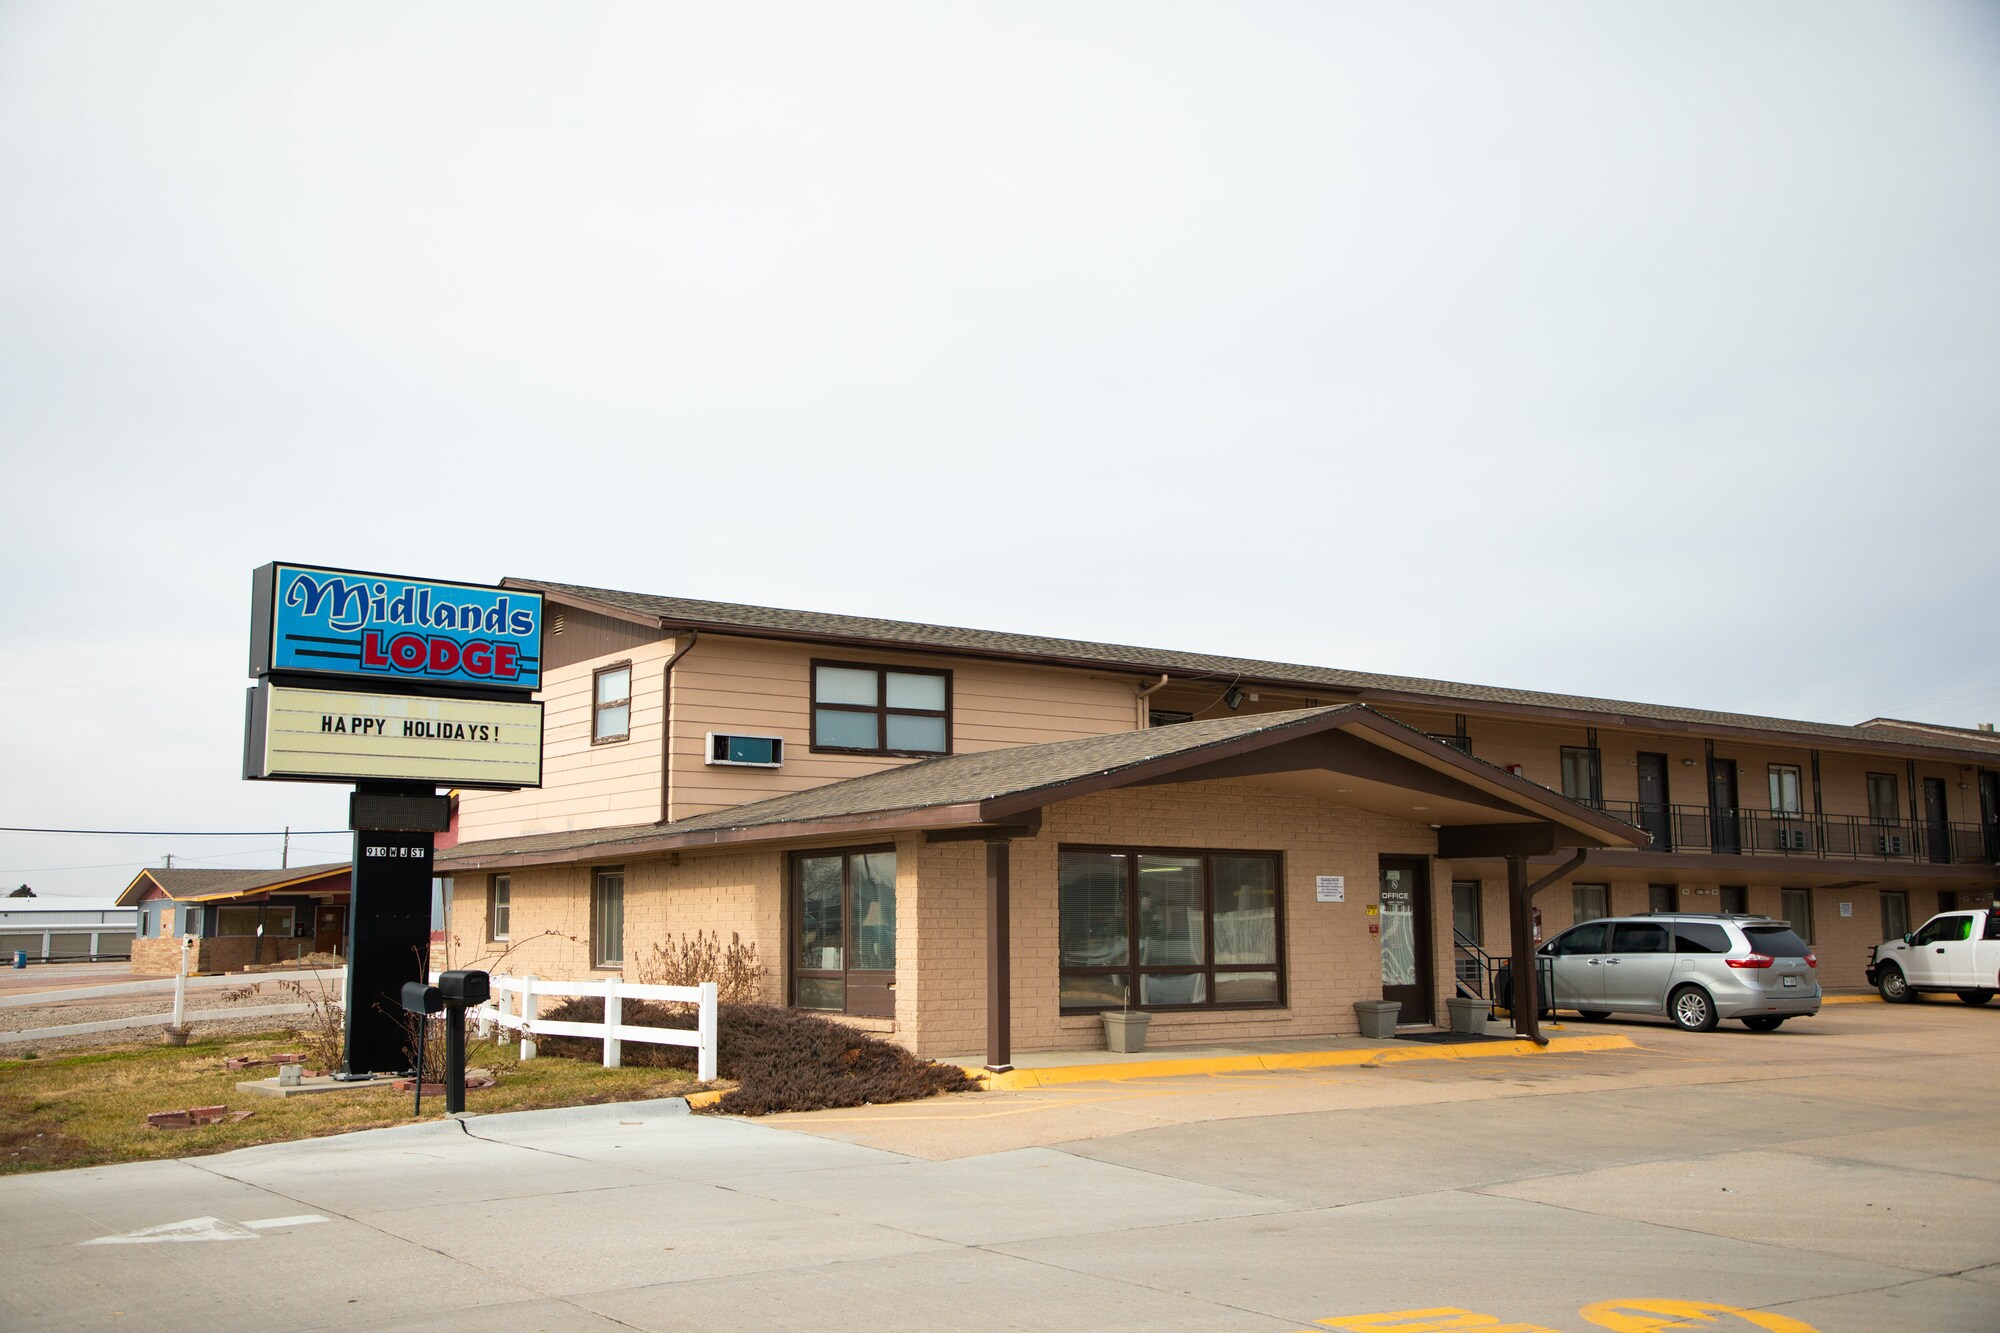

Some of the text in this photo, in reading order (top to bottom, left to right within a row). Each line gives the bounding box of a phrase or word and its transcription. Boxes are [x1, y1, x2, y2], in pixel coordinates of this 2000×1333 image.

[285, 574, 535, 637] Midlands
[362, 631, 520, 679] LODGE
[321, 715, 500, 742] HAPPY HOLIDAYS!
[367, 847, 424, 857] 910 W J ST
[1381, 892, 1409, 900] OFFICE
